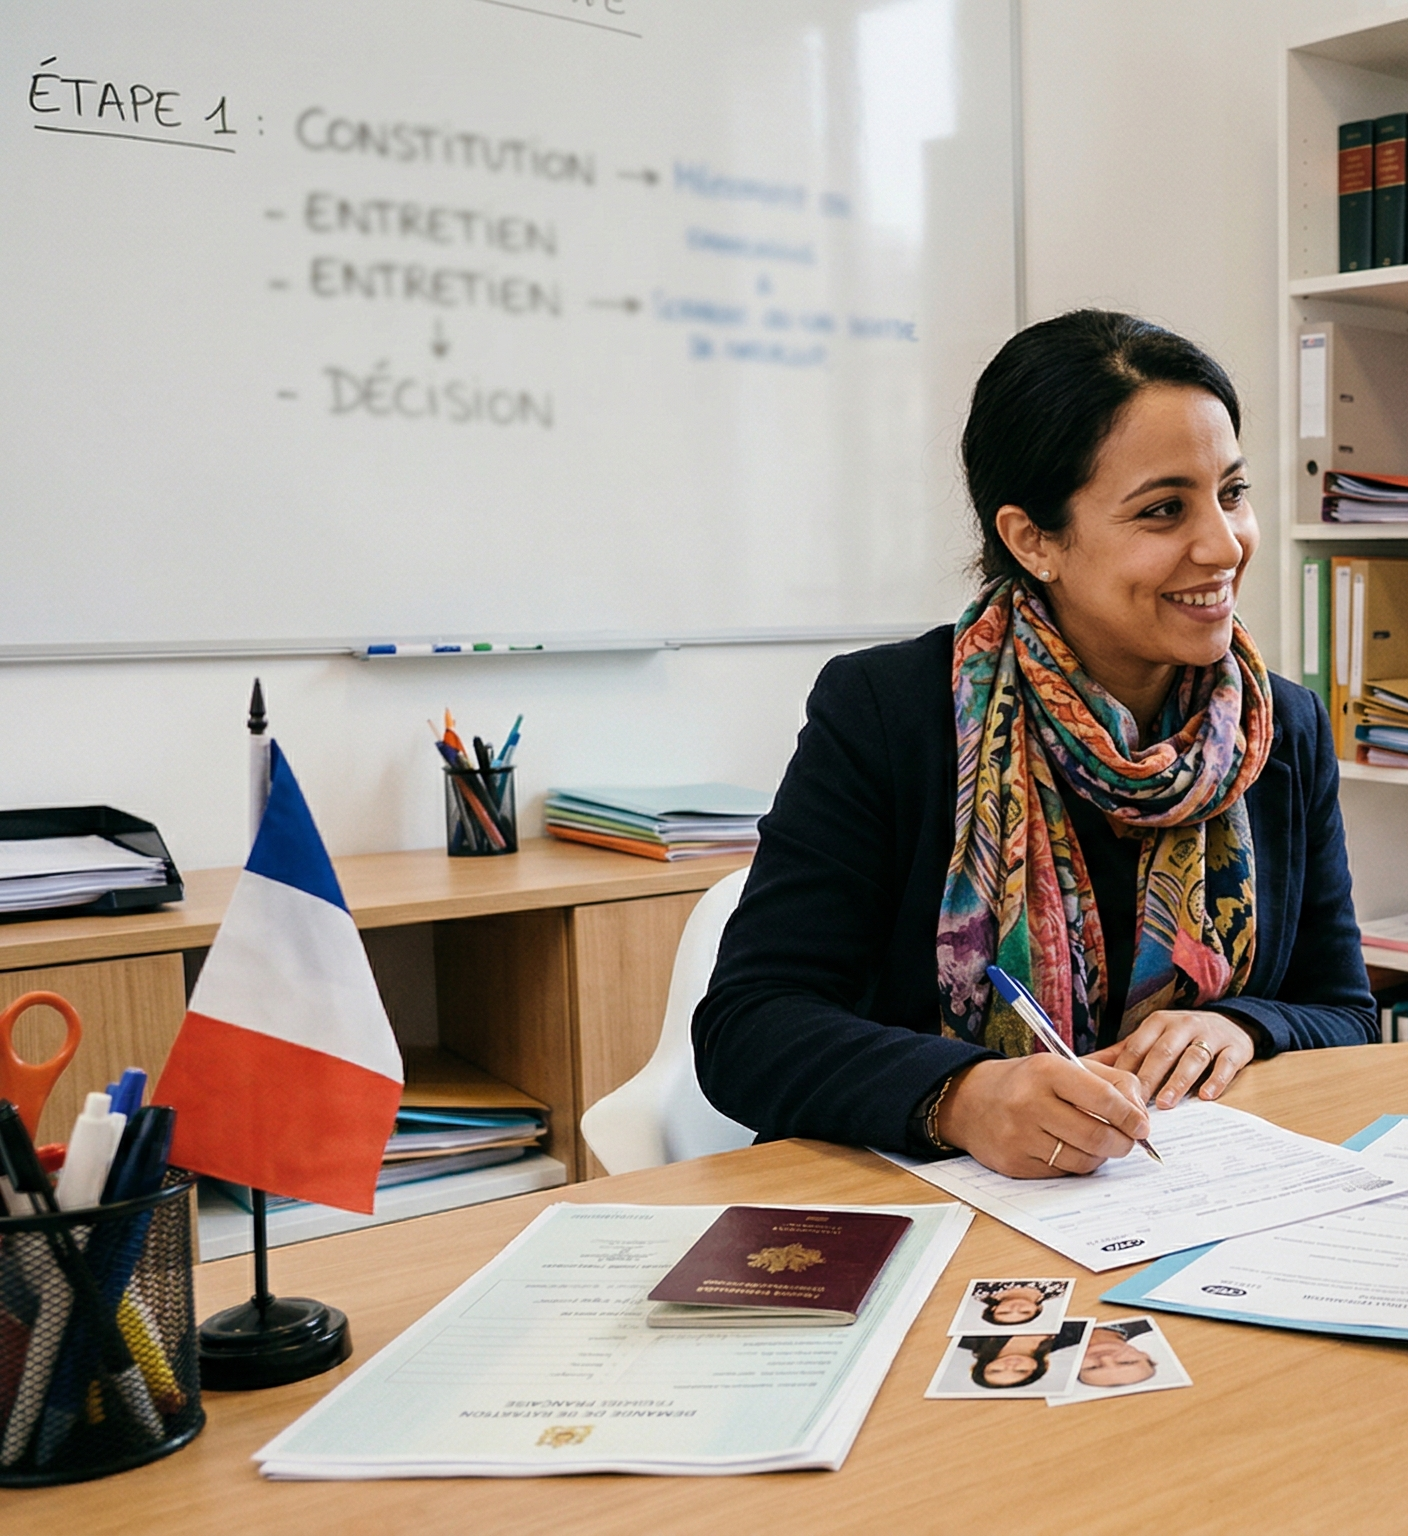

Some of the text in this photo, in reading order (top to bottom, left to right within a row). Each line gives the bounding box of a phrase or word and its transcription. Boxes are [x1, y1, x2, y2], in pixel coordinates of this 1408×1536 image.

[29, 57, 181, 126] ÉTAPE
[205, 96, 237, 134] 1
[294, 106, 598, 187] CONSTITUTION
[303, 190, 558, 257] ENTRETIEN
[308, 255, 562, 318] ENTRETIEN
[321, 360, 555, 431] DÉCISION
